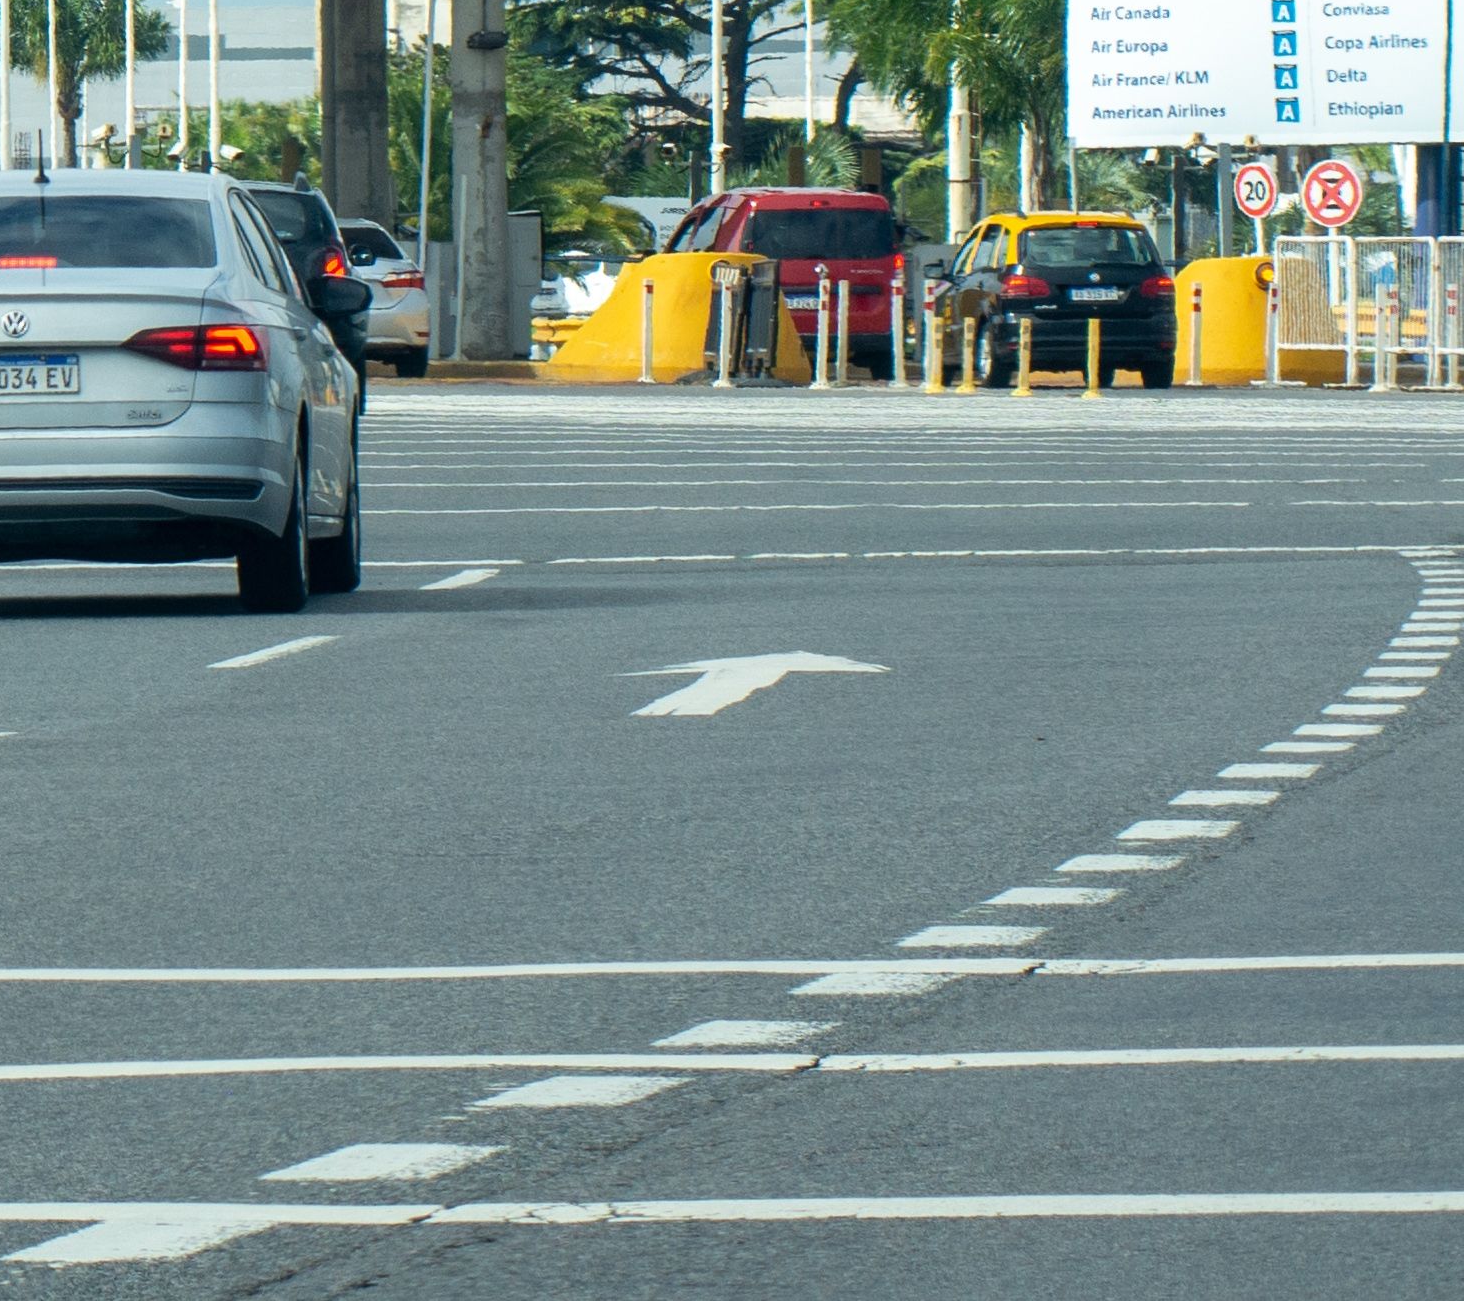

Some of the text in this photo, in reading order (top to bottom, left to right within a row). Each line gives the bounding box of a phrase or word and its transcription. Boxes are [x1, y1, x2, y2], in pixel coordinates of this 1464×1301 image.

[1091, 5, 1171, 21] Air Canada
[1277, 4, 1291, 21] A
[1322, 3, 1390, 17] Conviasa
[1091, 39, 1169, 56] Air Europa
[1279, 37, 1293, 54] A
[1325, 34, 1428, 52] Copa Airlines
[1092, 73, 1113, 87] Air
[1175, 70, 1210, 85] KLM
[1280, 71, 1294, 87] A
[1326, 68, 1368, 83] Delta
[1092, 104, 1227, 120] American Airlines
[1281, 104, 1295, 120] A
[1328, 101, 1404, 120] Ethiopian
[1244, 181, 1267, 202] 20
[47, 368, 74, 388] EV
